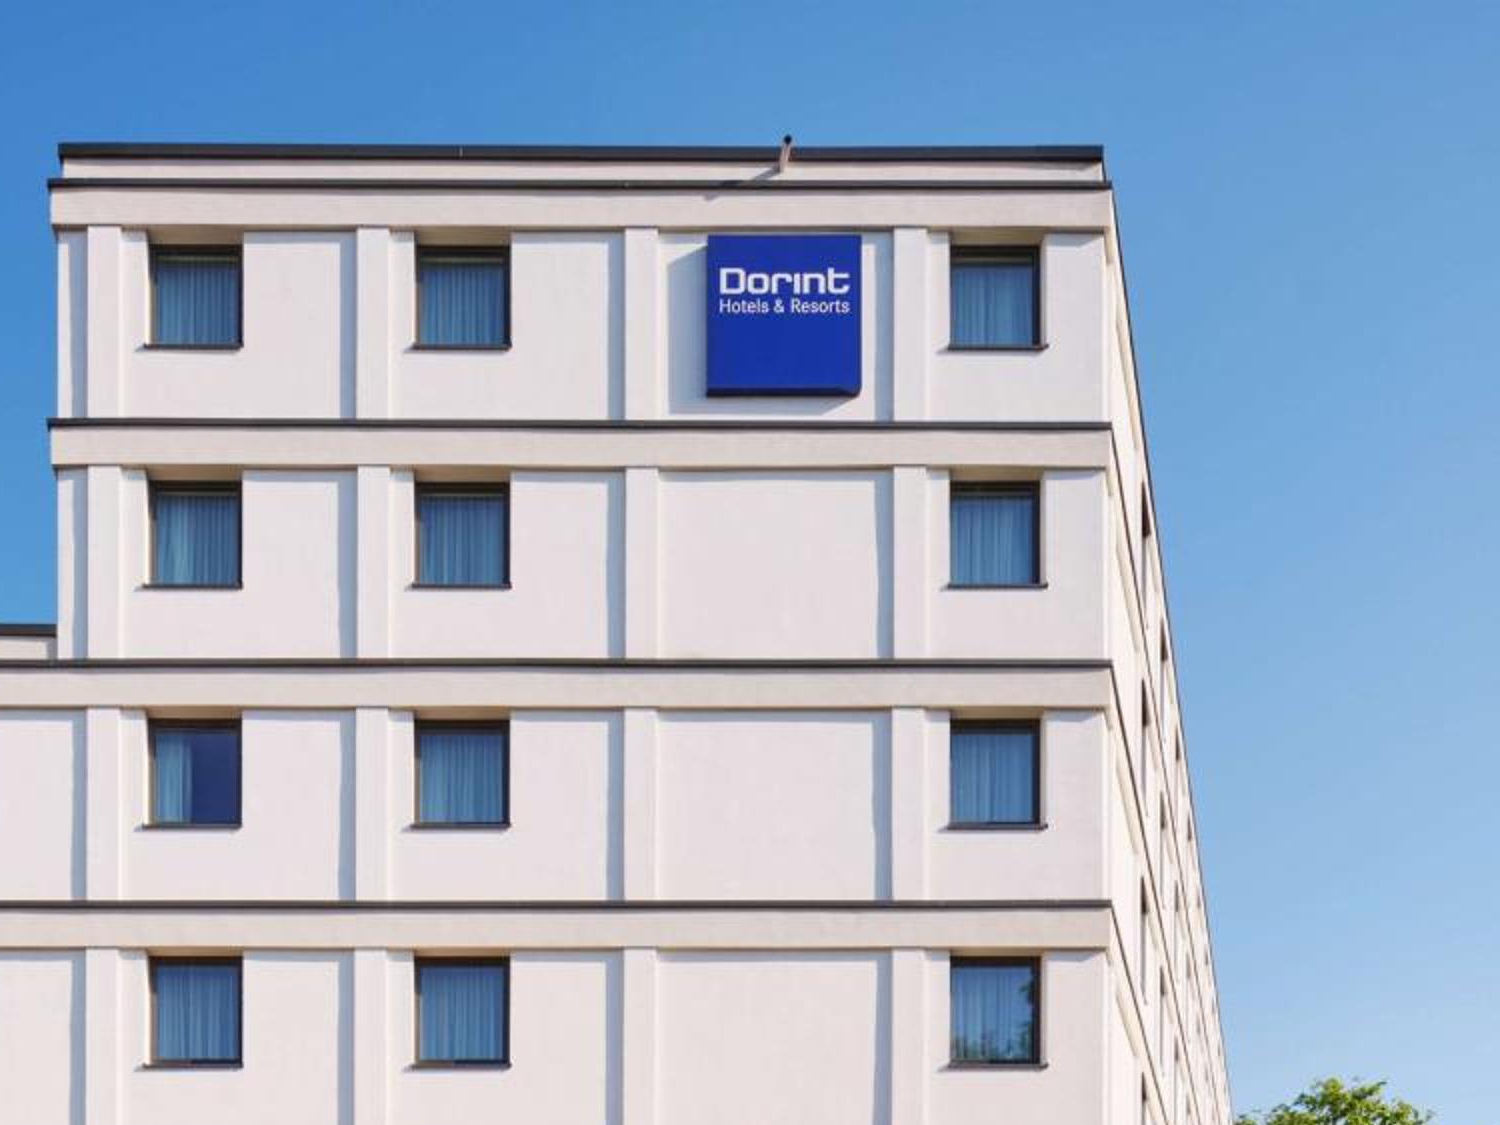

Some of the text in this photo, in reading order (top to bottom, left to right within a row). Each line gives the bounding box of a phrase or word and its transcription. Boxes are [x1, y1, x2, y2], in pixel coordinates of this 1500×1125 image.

[719, 267, 851, 295] Dorint
[719, 298, 851, 314] Hotels & Resorts
